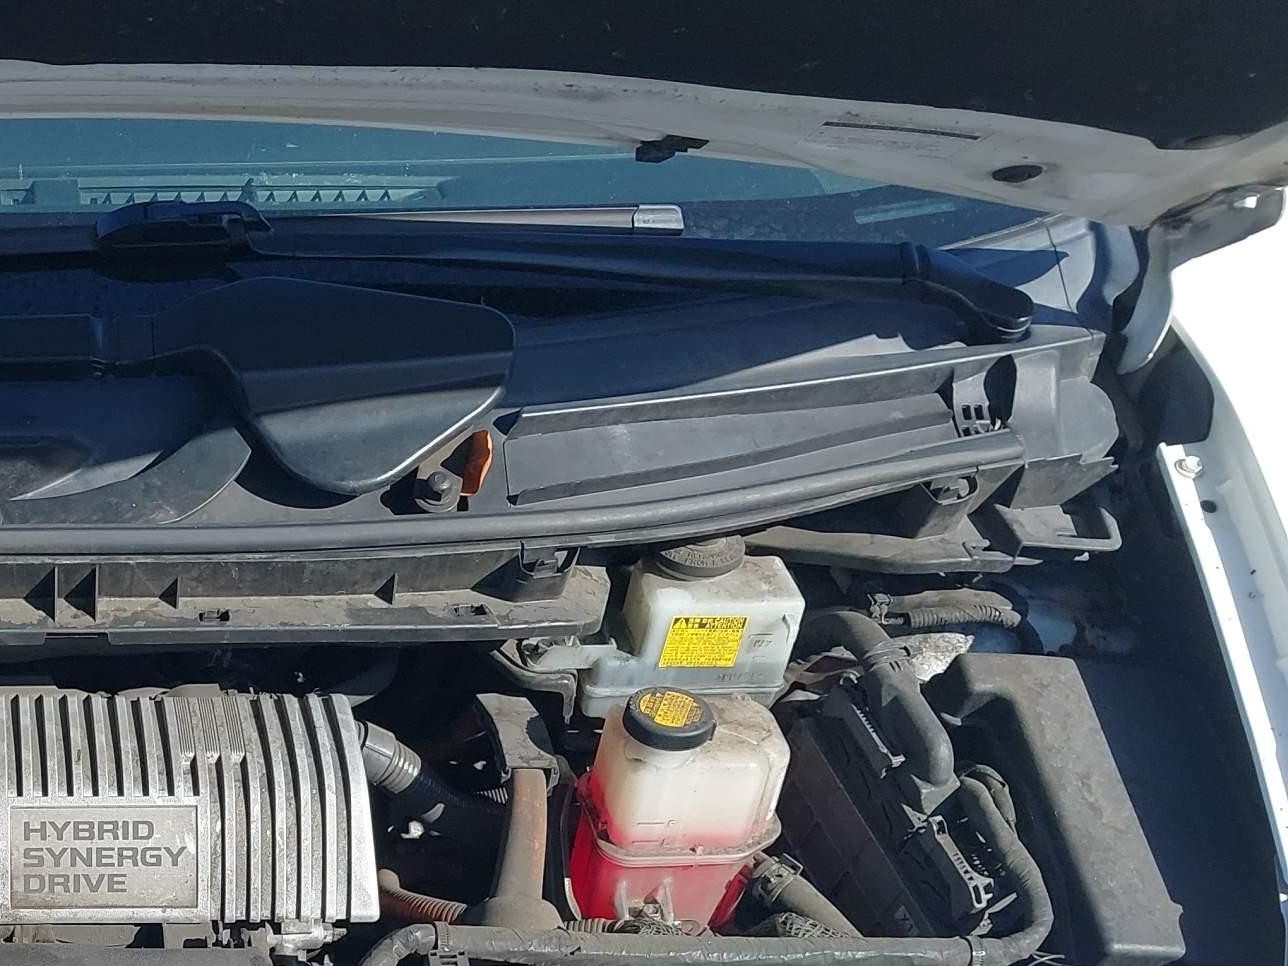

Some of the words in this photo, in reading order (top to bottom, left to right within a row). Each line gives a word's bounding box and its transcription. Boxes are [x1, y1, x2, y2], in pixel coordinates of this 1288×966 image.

[23, 820, 155, 841] HYBRID
[23, 846, 187, 868] SYNERGY
[23, 873, 128, 894] DRIVE
